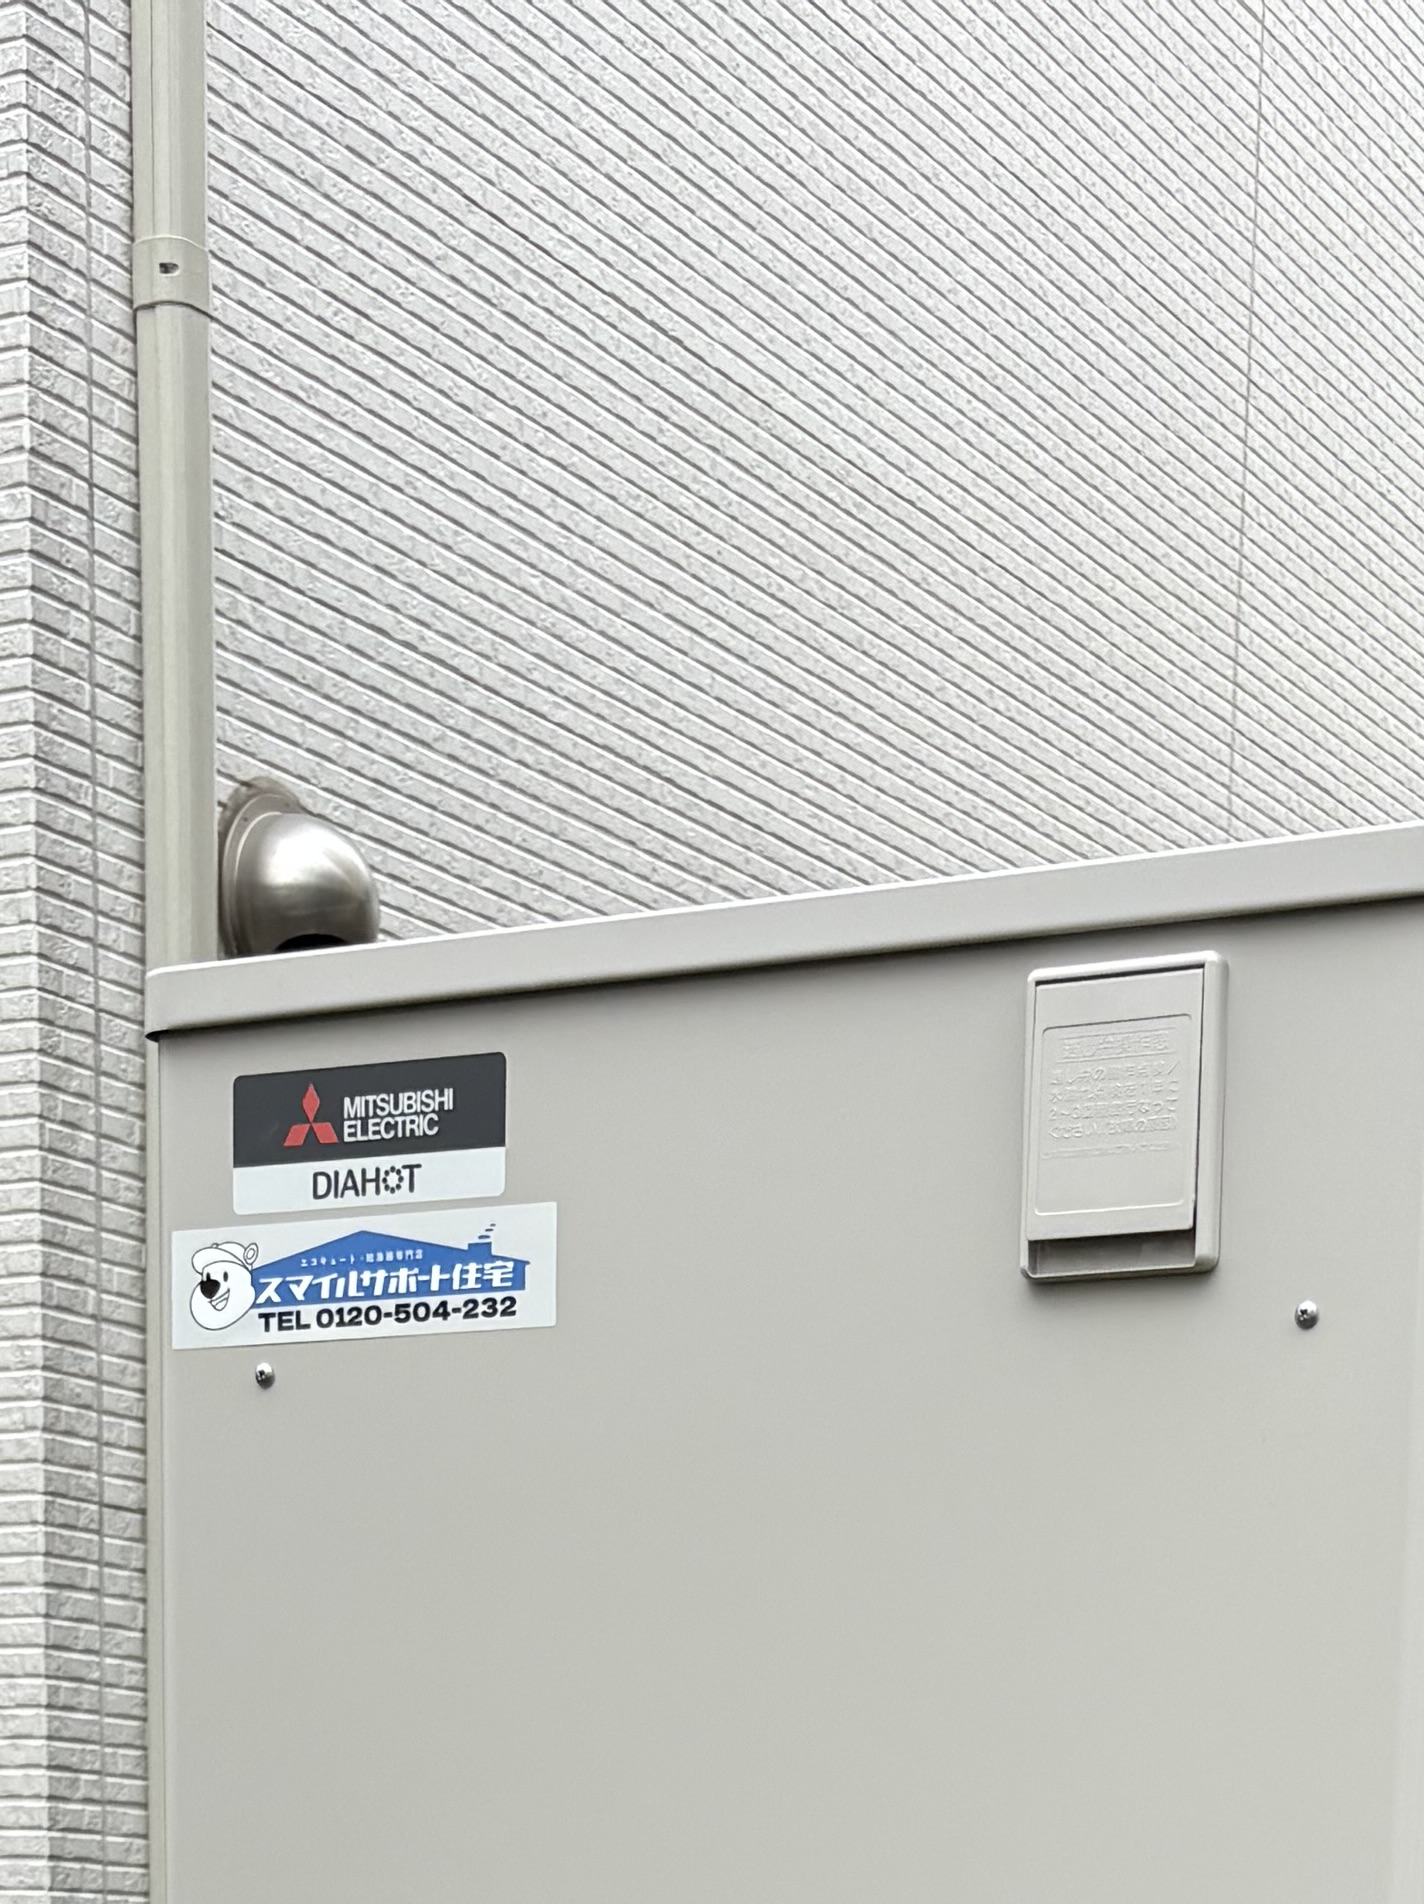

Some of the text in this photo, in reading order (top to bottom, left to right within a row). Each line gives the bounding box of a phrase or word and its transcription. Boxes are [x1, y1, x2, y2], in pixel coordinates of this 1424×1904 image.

[343, 1088, 453, 1119] MITSUBISHI
[343, 1113, 439, 1143] ELECTRIC
[312, 1164, 422, 1200] DIAHOT
[256, 1260, 514, 1304] スマイルサポート住宅
[258, 1296, 517, 1333] TEL 0120-504-232
